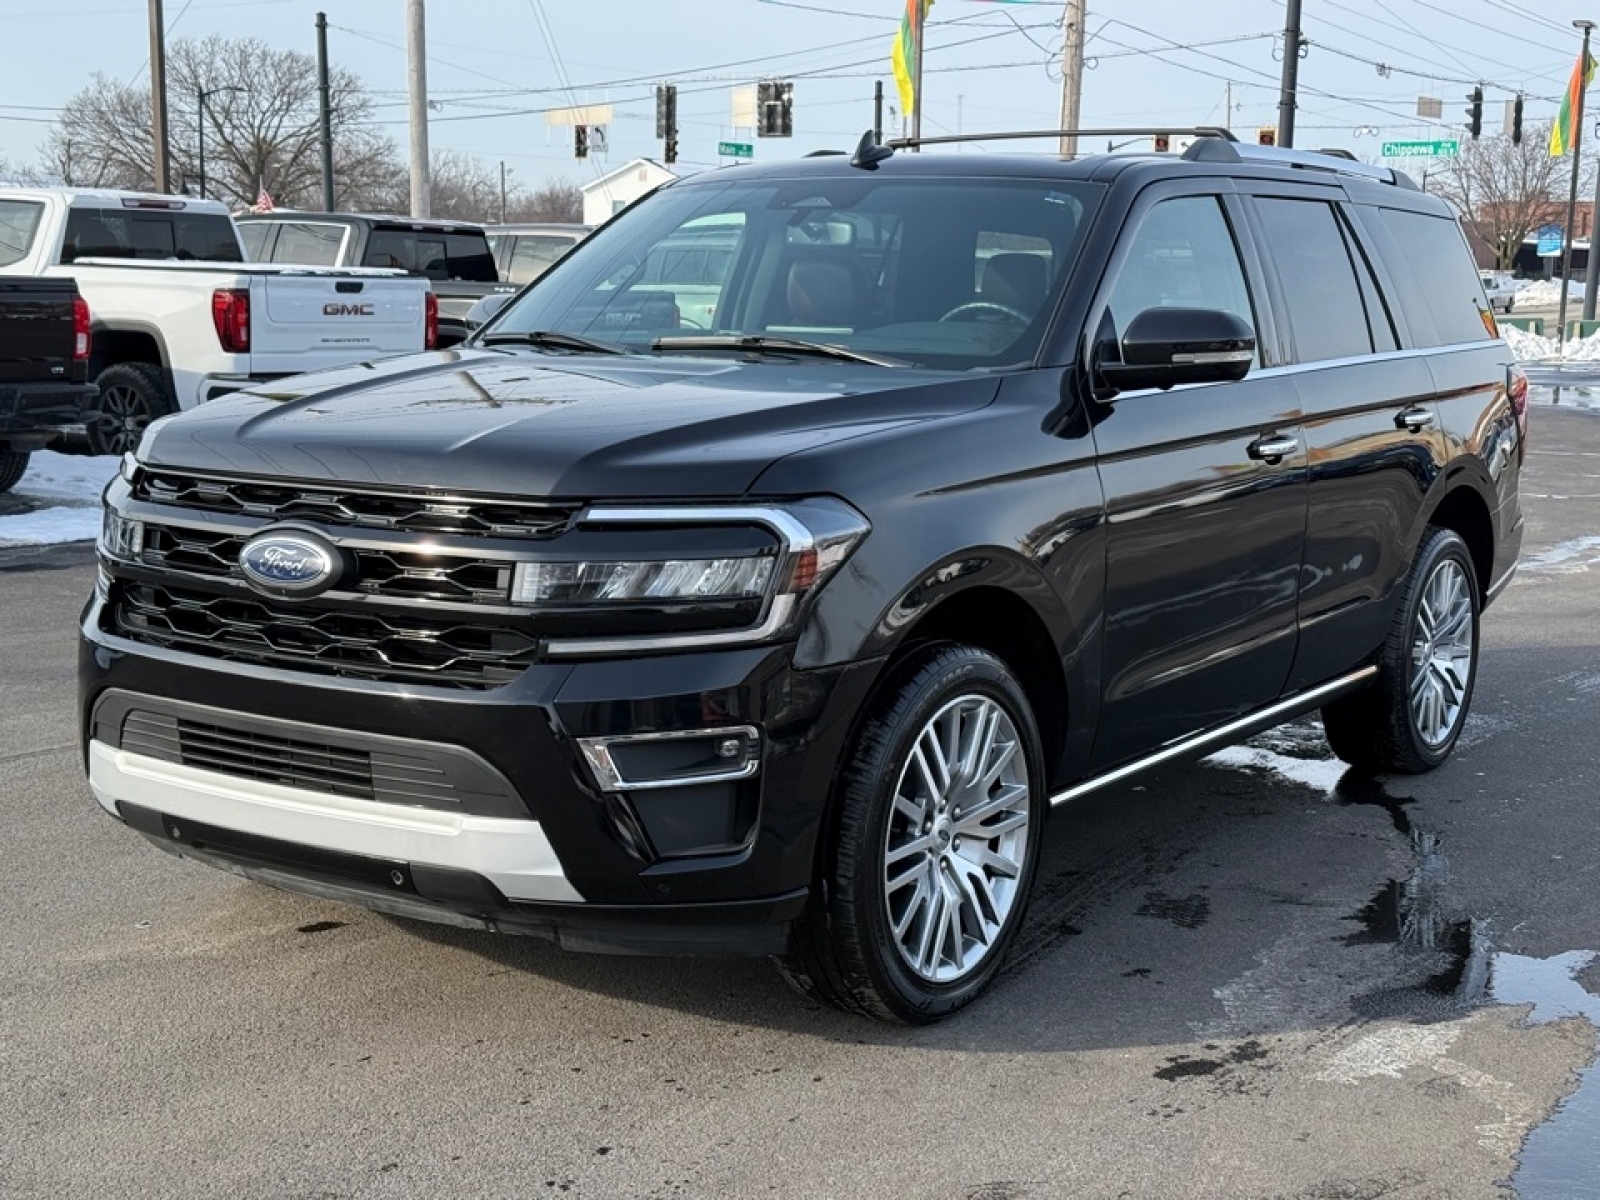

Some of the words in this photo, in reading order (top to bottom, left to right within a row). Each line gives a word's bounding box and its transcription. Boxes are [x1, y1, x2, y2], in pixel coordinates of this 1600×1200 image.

[1384, 143, 1434, 157] Chippewa
[323, 303, 375, 316] GMC
[259, 546, 308, 574] Ford
